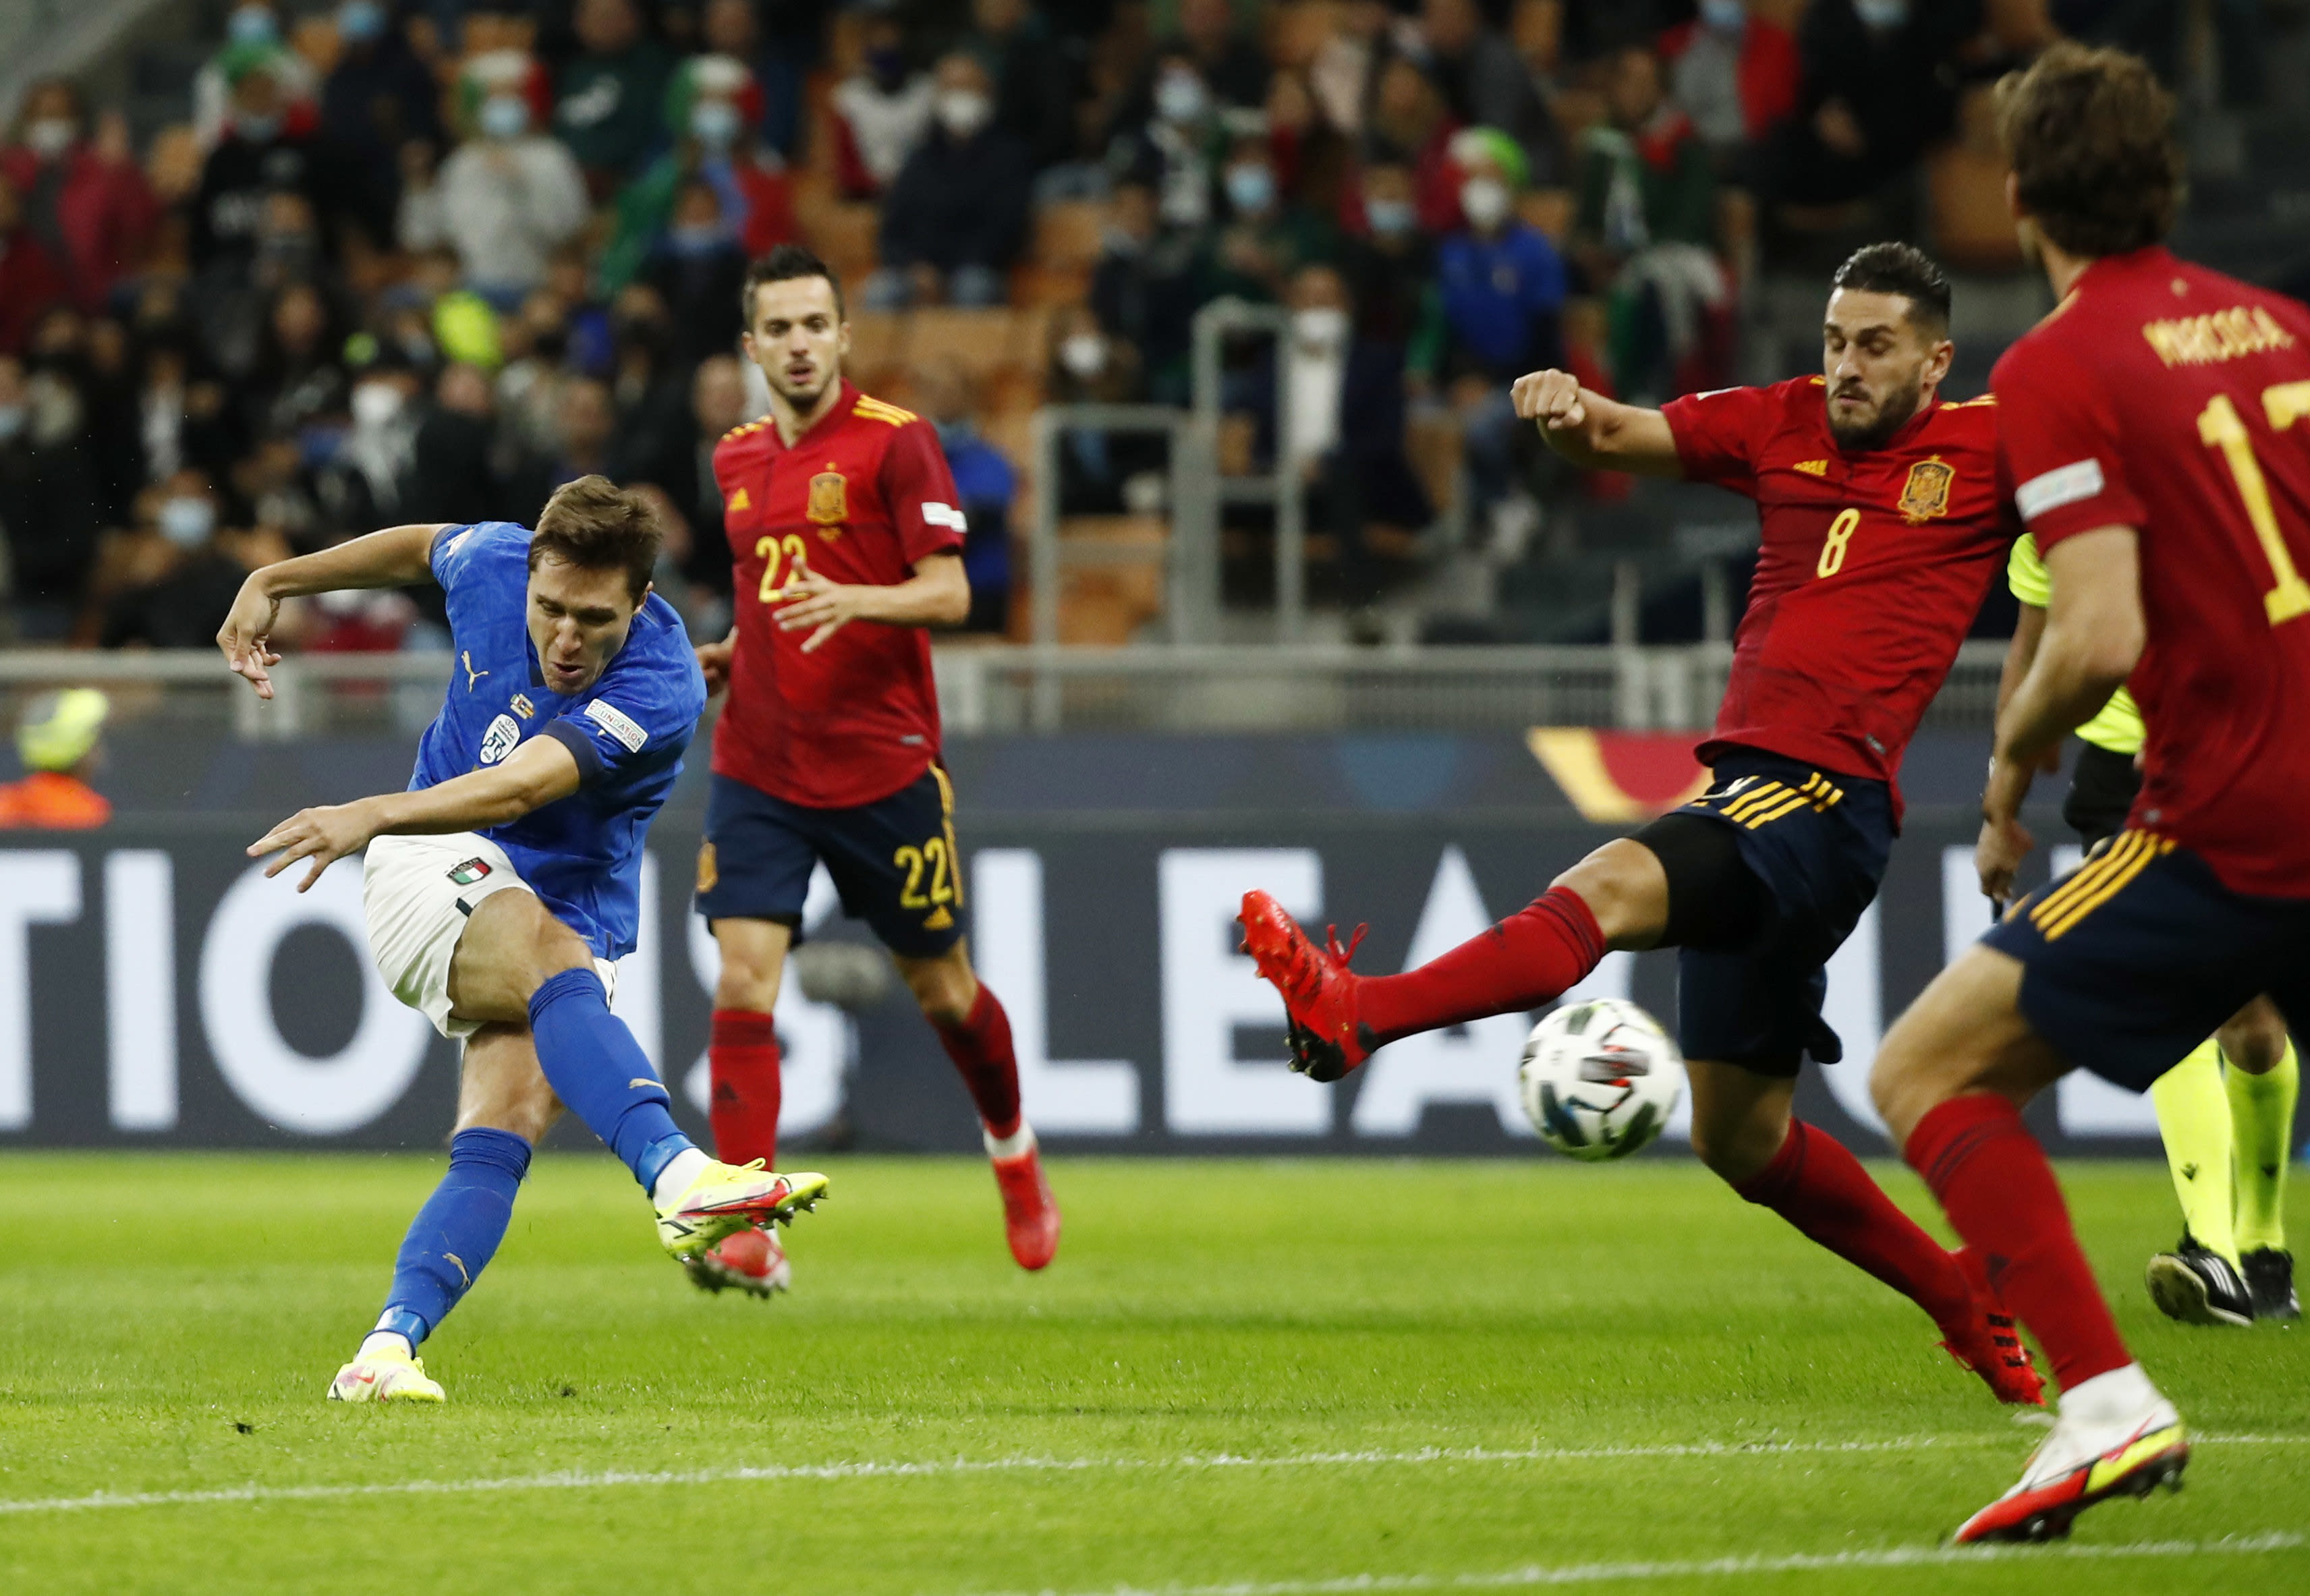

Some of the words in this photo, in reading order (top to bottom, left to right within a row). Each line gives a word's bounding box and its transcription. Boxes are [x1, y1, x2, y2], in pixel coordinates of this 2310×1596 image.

[755, 534, 808, 604] 22
[1817, 508, 1861, 579] 8
[588, 704, 644, 746] FOUNDATION
[894, 836, 953, 908] 22
